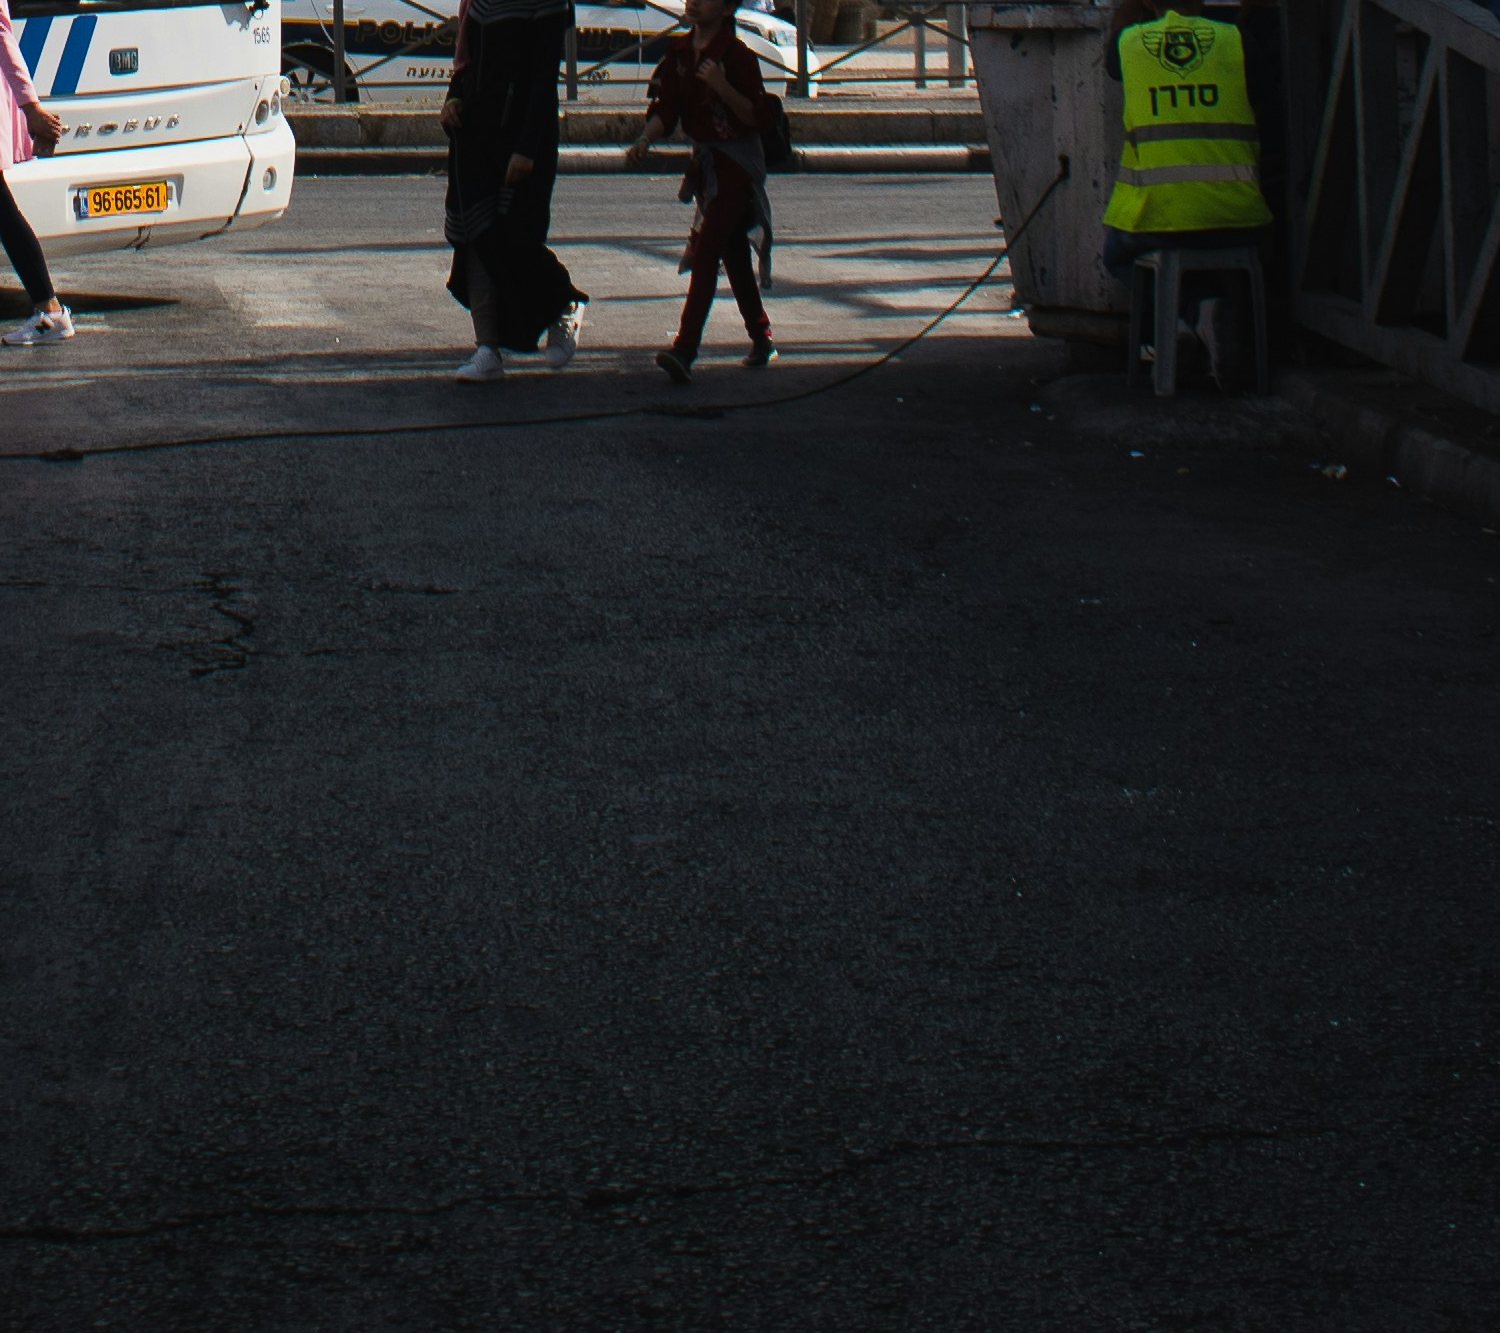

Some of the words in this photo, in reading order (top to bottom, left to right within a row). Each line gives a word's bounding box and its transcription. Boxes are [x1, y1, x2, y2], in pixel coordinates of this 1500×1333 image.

[253, 26, 271, 45] 1565
[355, 18, 457, 46] POLIC
[1148, 83, 1219, 118] סדרן
